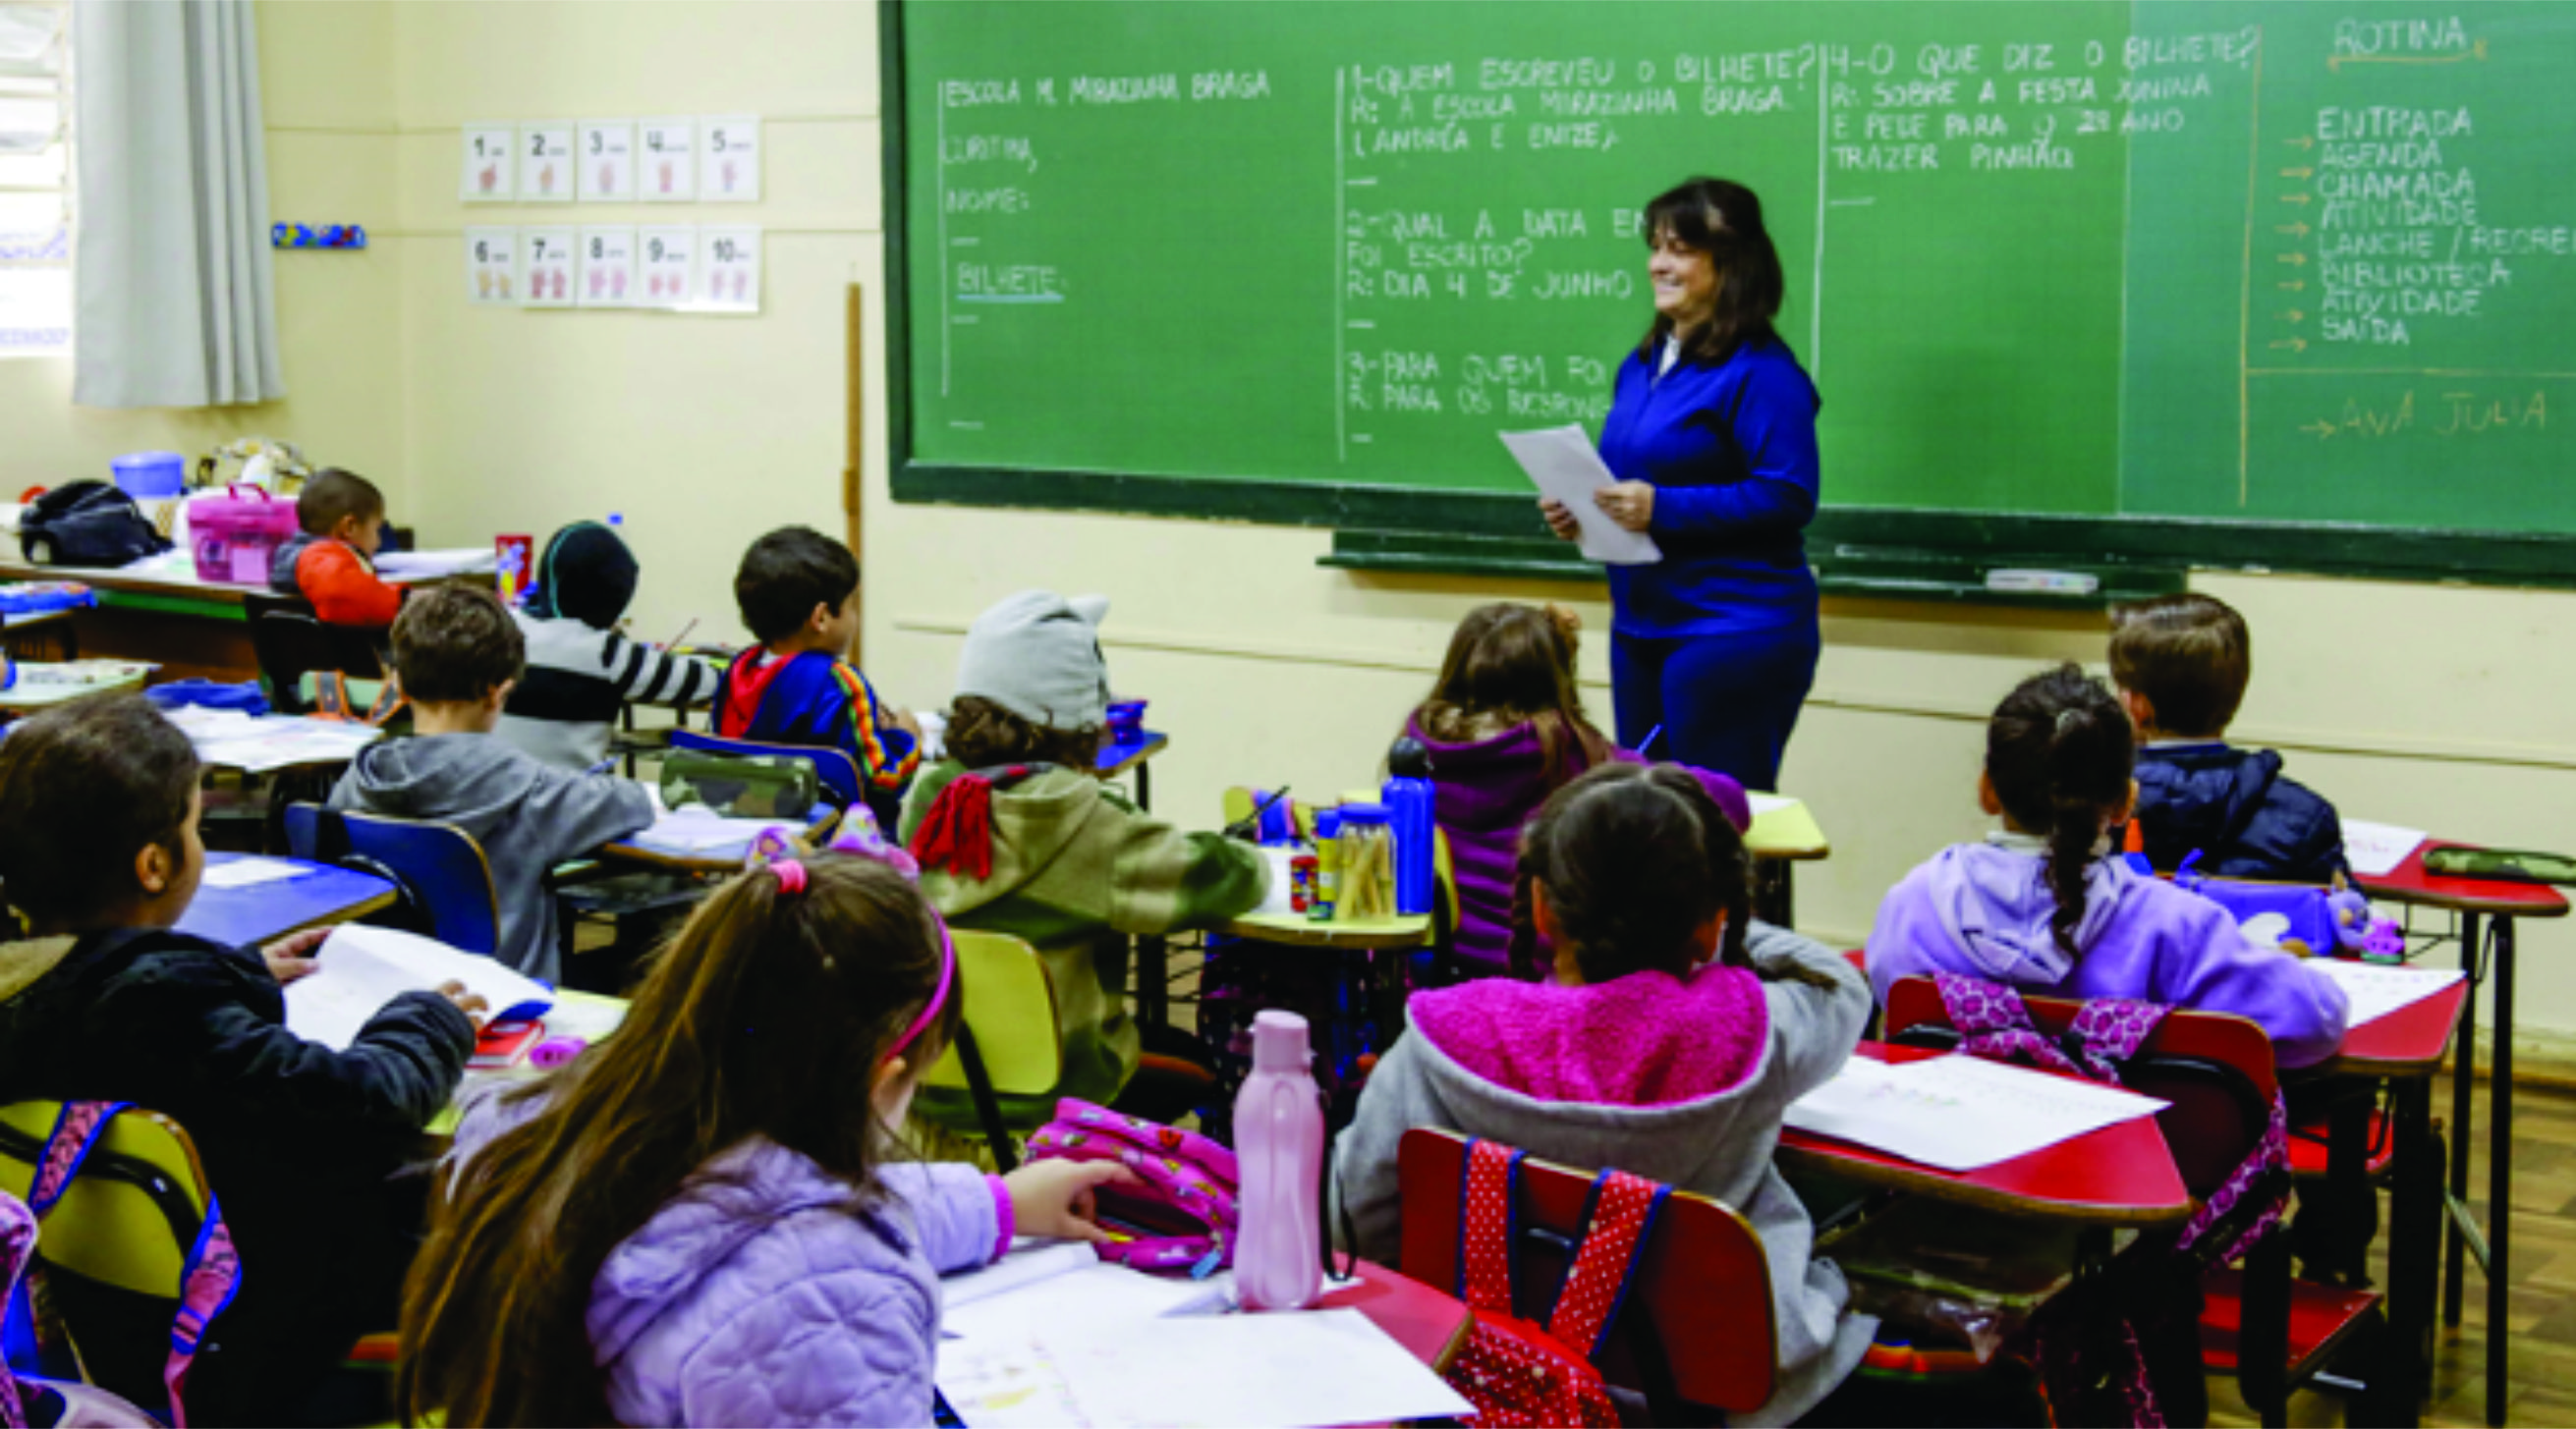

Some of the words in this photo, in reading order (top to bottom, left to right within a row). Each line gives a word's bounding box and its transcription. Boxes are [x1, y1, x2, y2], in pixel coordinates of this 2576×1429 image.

[2334, 16, 2467, 54] ROTINA
[1917, 43, 1980, 79] QUE
[2002, 43, 2054, 73] DIZ
[2085, 40, 2104, 68] O
[1191, 69, 1270, 101] BRAGA
[1978, 80, 1996, 104] A
[2018, 78, 2097, 103] FESTA
[1833, 113, 1849, 140] E
[1945, 111, 2007, 139] PARA
[2317, 105, 2473, 140] ENTRADA
[475, 136, 484, 157] 1
[532, 134, 545, 157] 2
[590, 130, 603, 154] 3
[646, 130, 663, 152] 4
[712, 128, 726, 153] 5
[1833, 143, 1939, 170] TRAZER
[2321, 140, 2442, 169] AGENDA
[2318, 168, 2475, 201] CHAMADA
[1476, 208, 1494, 239] A
[1524, 209, 1587, 239] DATA
[476, 241, 488, 262] 6
[532, 238, 545, 262] 7
[590, 236, 603, 259] 8
[648, 237, 663, 262] 9
[713, 238, 735, 263] 10
[1383, 269, 1430, 299] DIA
[1446, 271, 1467, 299] 4
[1486, 269, 1516, 299] DE
[1533, 270, 1632, 300] JUNHO
[1462, 354, 1547, 388] QUEM
